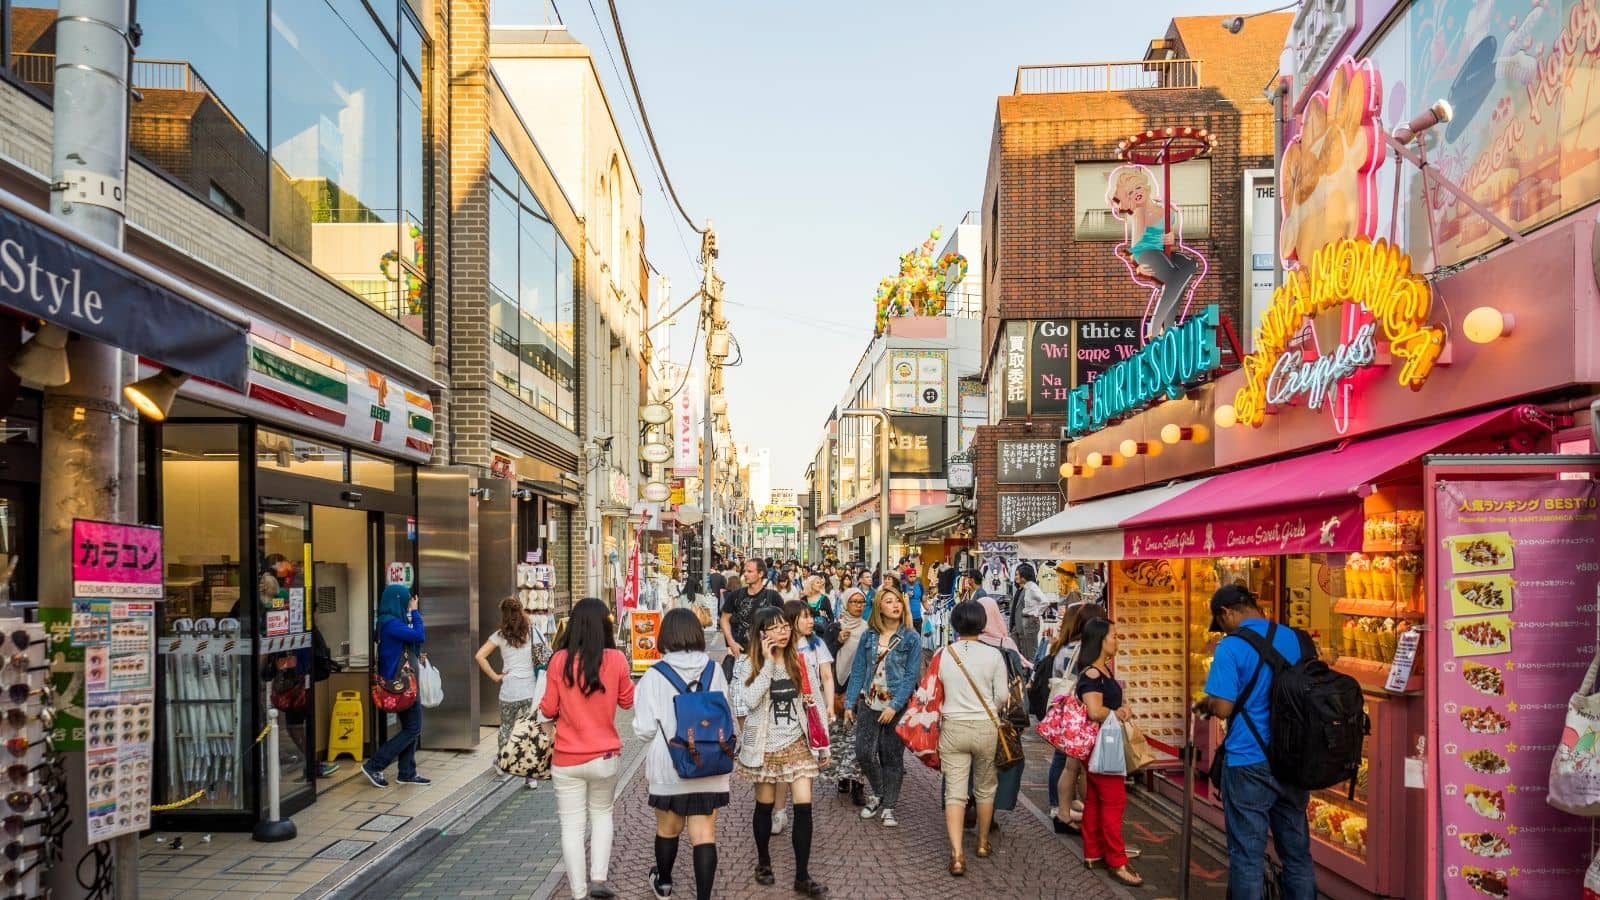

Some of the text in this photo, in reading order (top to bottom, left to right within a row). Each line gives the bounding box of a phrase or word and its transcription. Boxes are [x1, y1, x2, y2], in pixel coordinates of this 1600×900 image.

[1256, 187, 1274, 199] THE
[0, 239, 104, 325] Style
[1124, 327, 1136, 337] &
[1008, 336, 1024, 400] 買取委託
[1092, 303, 1217, 430] BURLESQUE
[1458, 499, 1539, 513] 人気ランキング
[80, 539, 157, 570] カラコン
[116, 585, 144, 593] CONTACT
[145, 586, 161, 594] LENS
